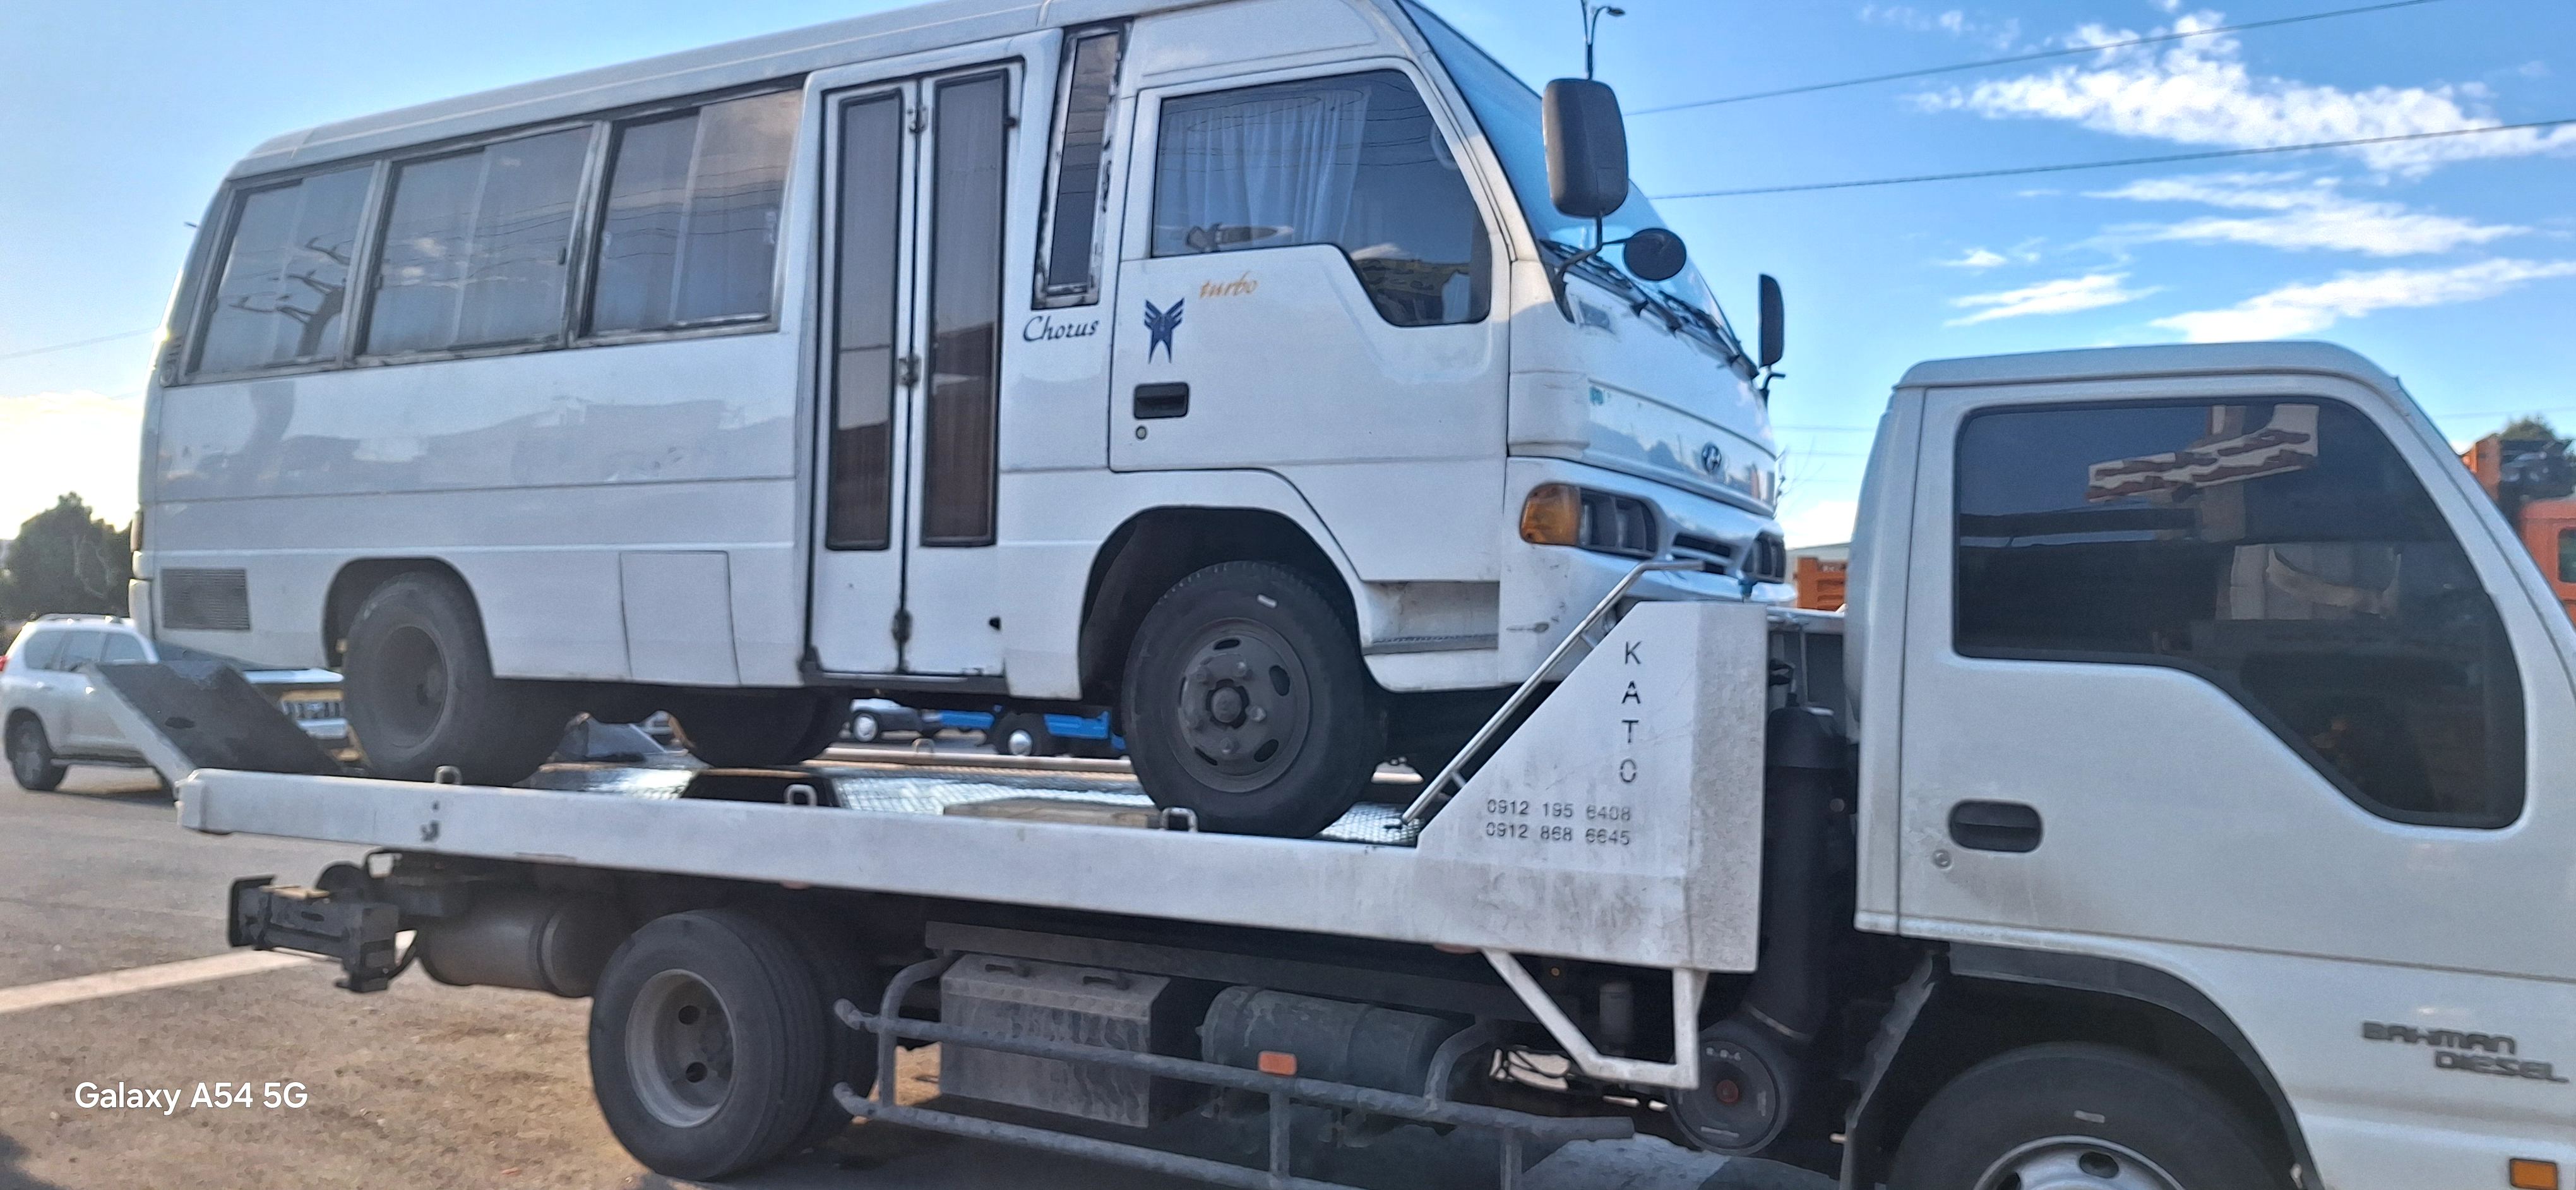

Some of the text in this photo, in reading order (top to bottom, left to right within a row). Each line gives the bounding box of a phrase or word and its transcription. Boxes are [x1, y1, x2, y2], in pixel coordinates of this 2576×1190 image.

[1200, 270, 1259, 299] turbo
[1022, 315, 1100, 342] Chorus
[1619, 640, 1643, 784] KATO
[1487, 798, 1631, 821] 0912 195 6408
[1486, 822, 1631, 846] 0912 868 6645
